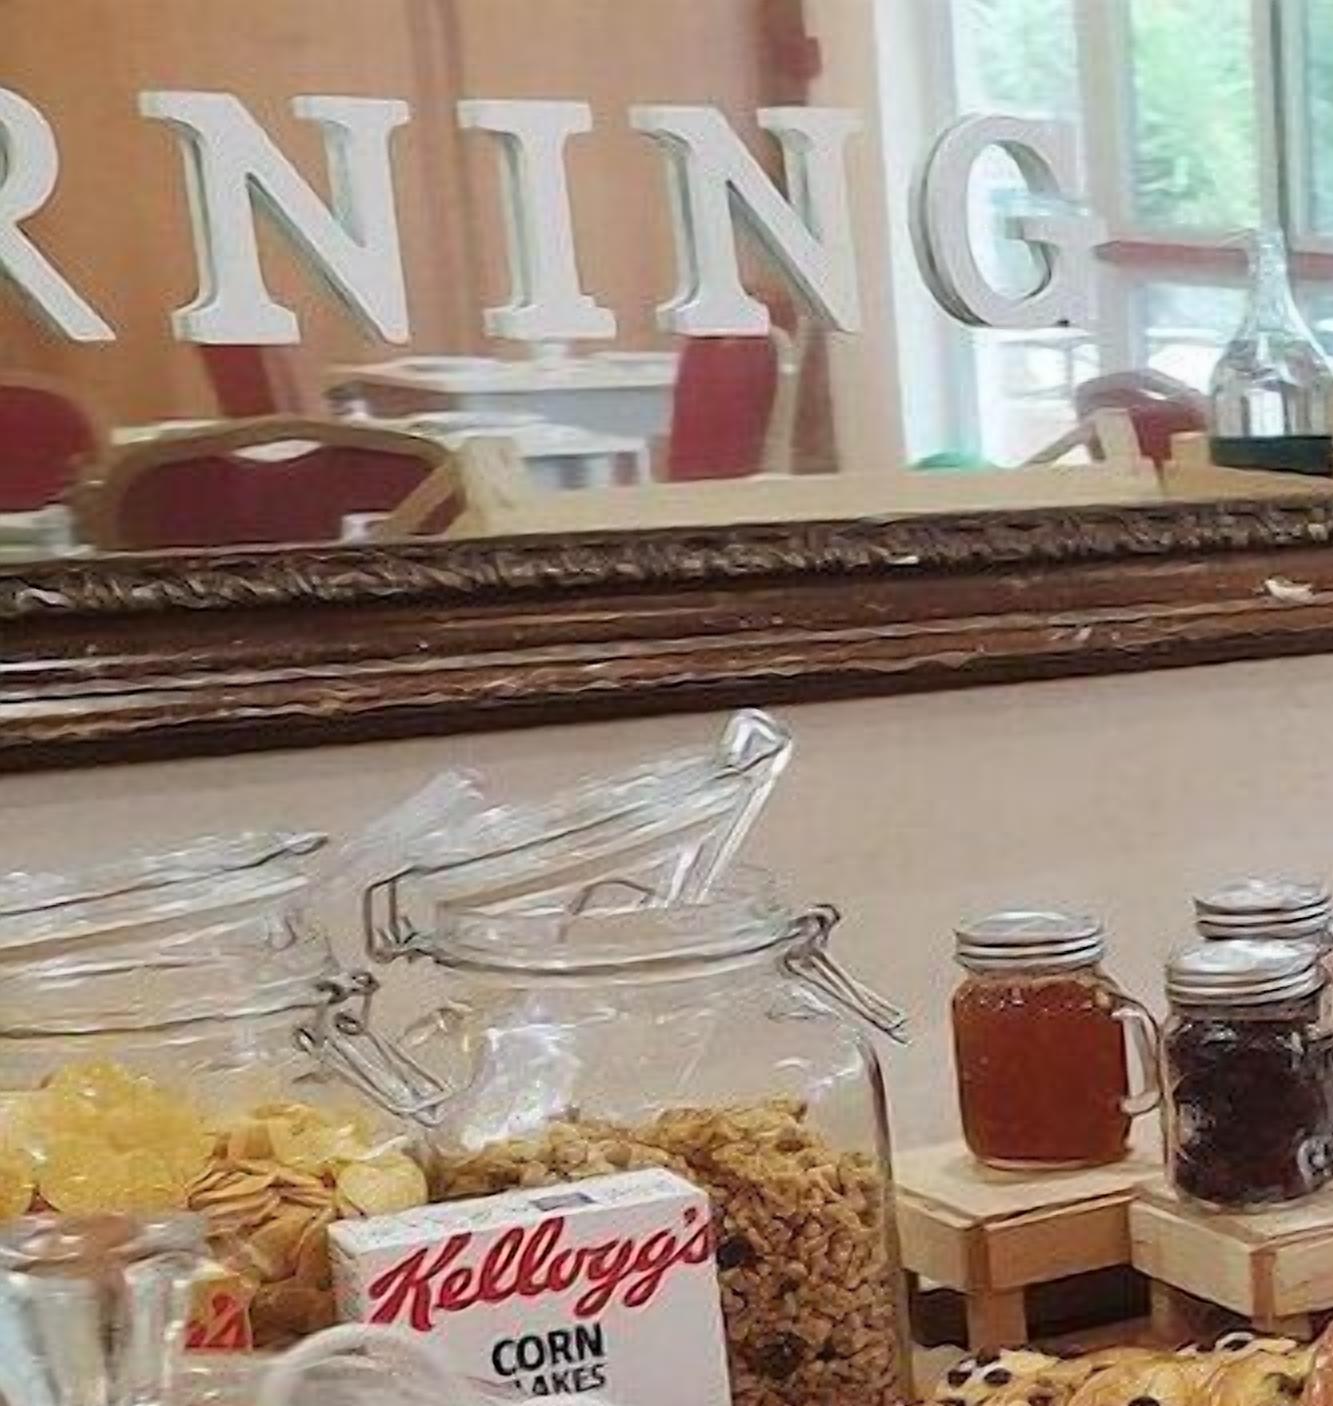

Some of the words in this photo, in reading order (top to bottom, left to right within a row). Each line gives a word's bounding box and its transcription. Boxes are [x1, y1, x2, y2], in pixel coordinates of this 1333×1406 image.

[368, 1206, 713, 1332] Kellogg's
[491, 1322, 605, 1377] CORN
[514, 1362, 608, 1396] AKES
